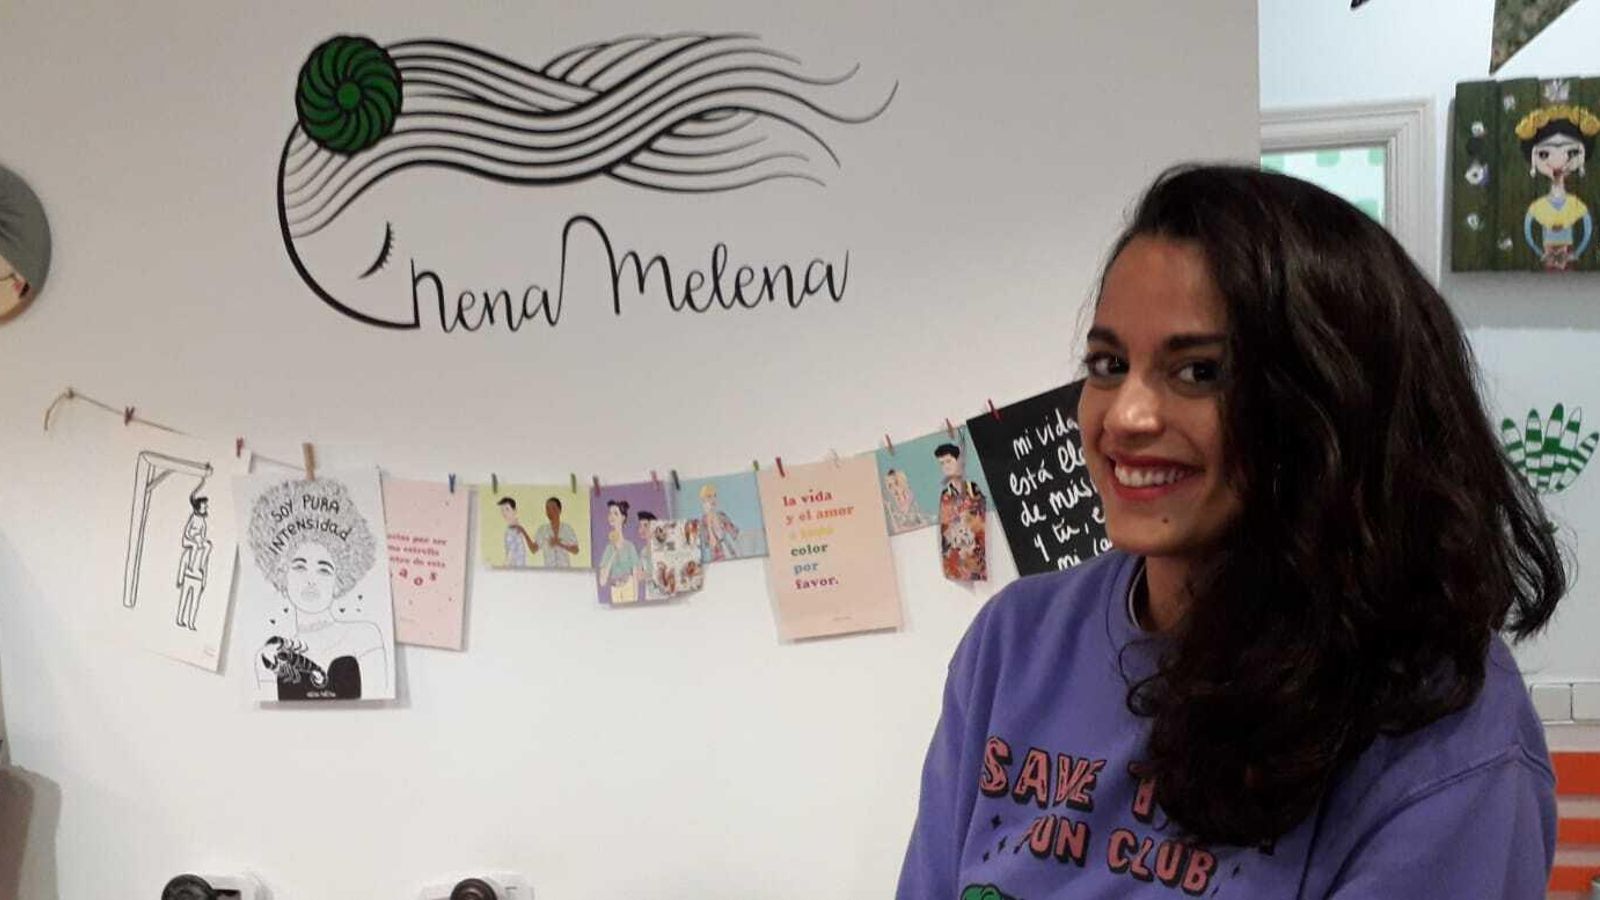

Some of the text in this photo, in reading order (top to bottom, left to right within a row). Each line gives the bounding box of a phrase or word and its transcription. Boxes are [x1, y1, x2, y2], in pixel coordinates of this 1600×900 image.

[1036, 408, 1080, 446] vida
[1009, 459, 1053, 496] está
[302, 494, 340, 514] PURA
[783, 489, 832, 507] la vida
[785, 505, 854, 525] y el amor
[1020, 500, 1047, 527] de
[790, 543, 828, 556] color
[1034, 533, 1050, 562] y
[793, 561, 819, 574] por
[795, 577, 839, 591] favor.
[980, 736, 1107, 813] SAVE
[1014, 814, 1218, 897] UN CLUB
